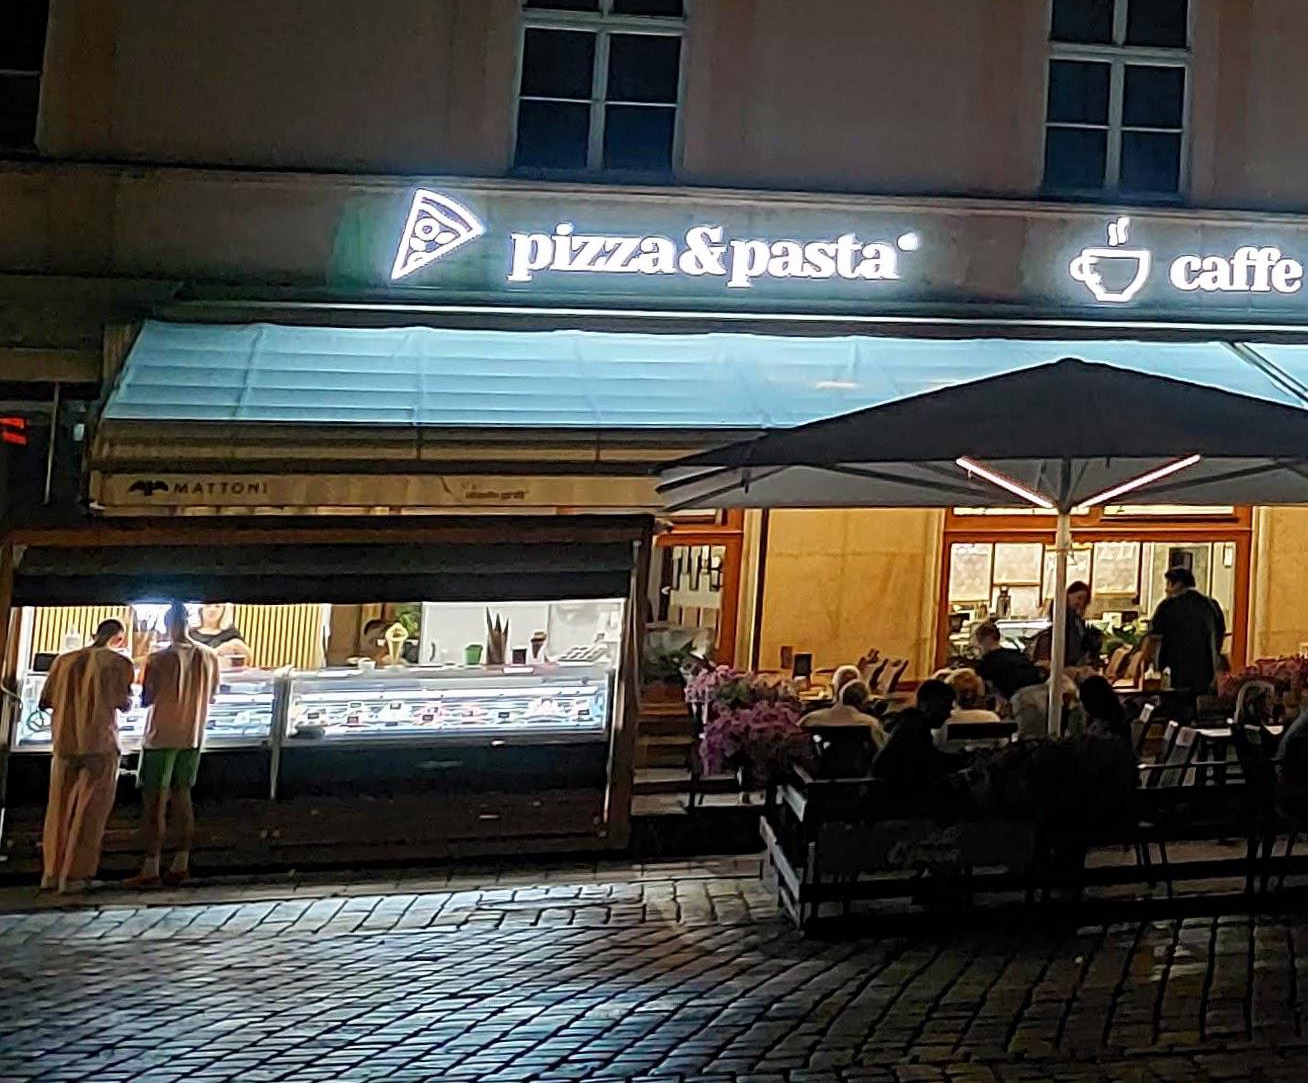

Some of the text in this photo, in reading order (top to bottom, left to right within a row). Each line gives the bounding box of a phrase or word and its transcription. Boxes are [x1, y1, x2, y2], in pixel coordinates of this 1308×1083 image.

[507, 222, 900, 288] pizza&pasta
[1169, 245, 1303, 293] caffe
[173, 482, 269, 495] MATTONI
